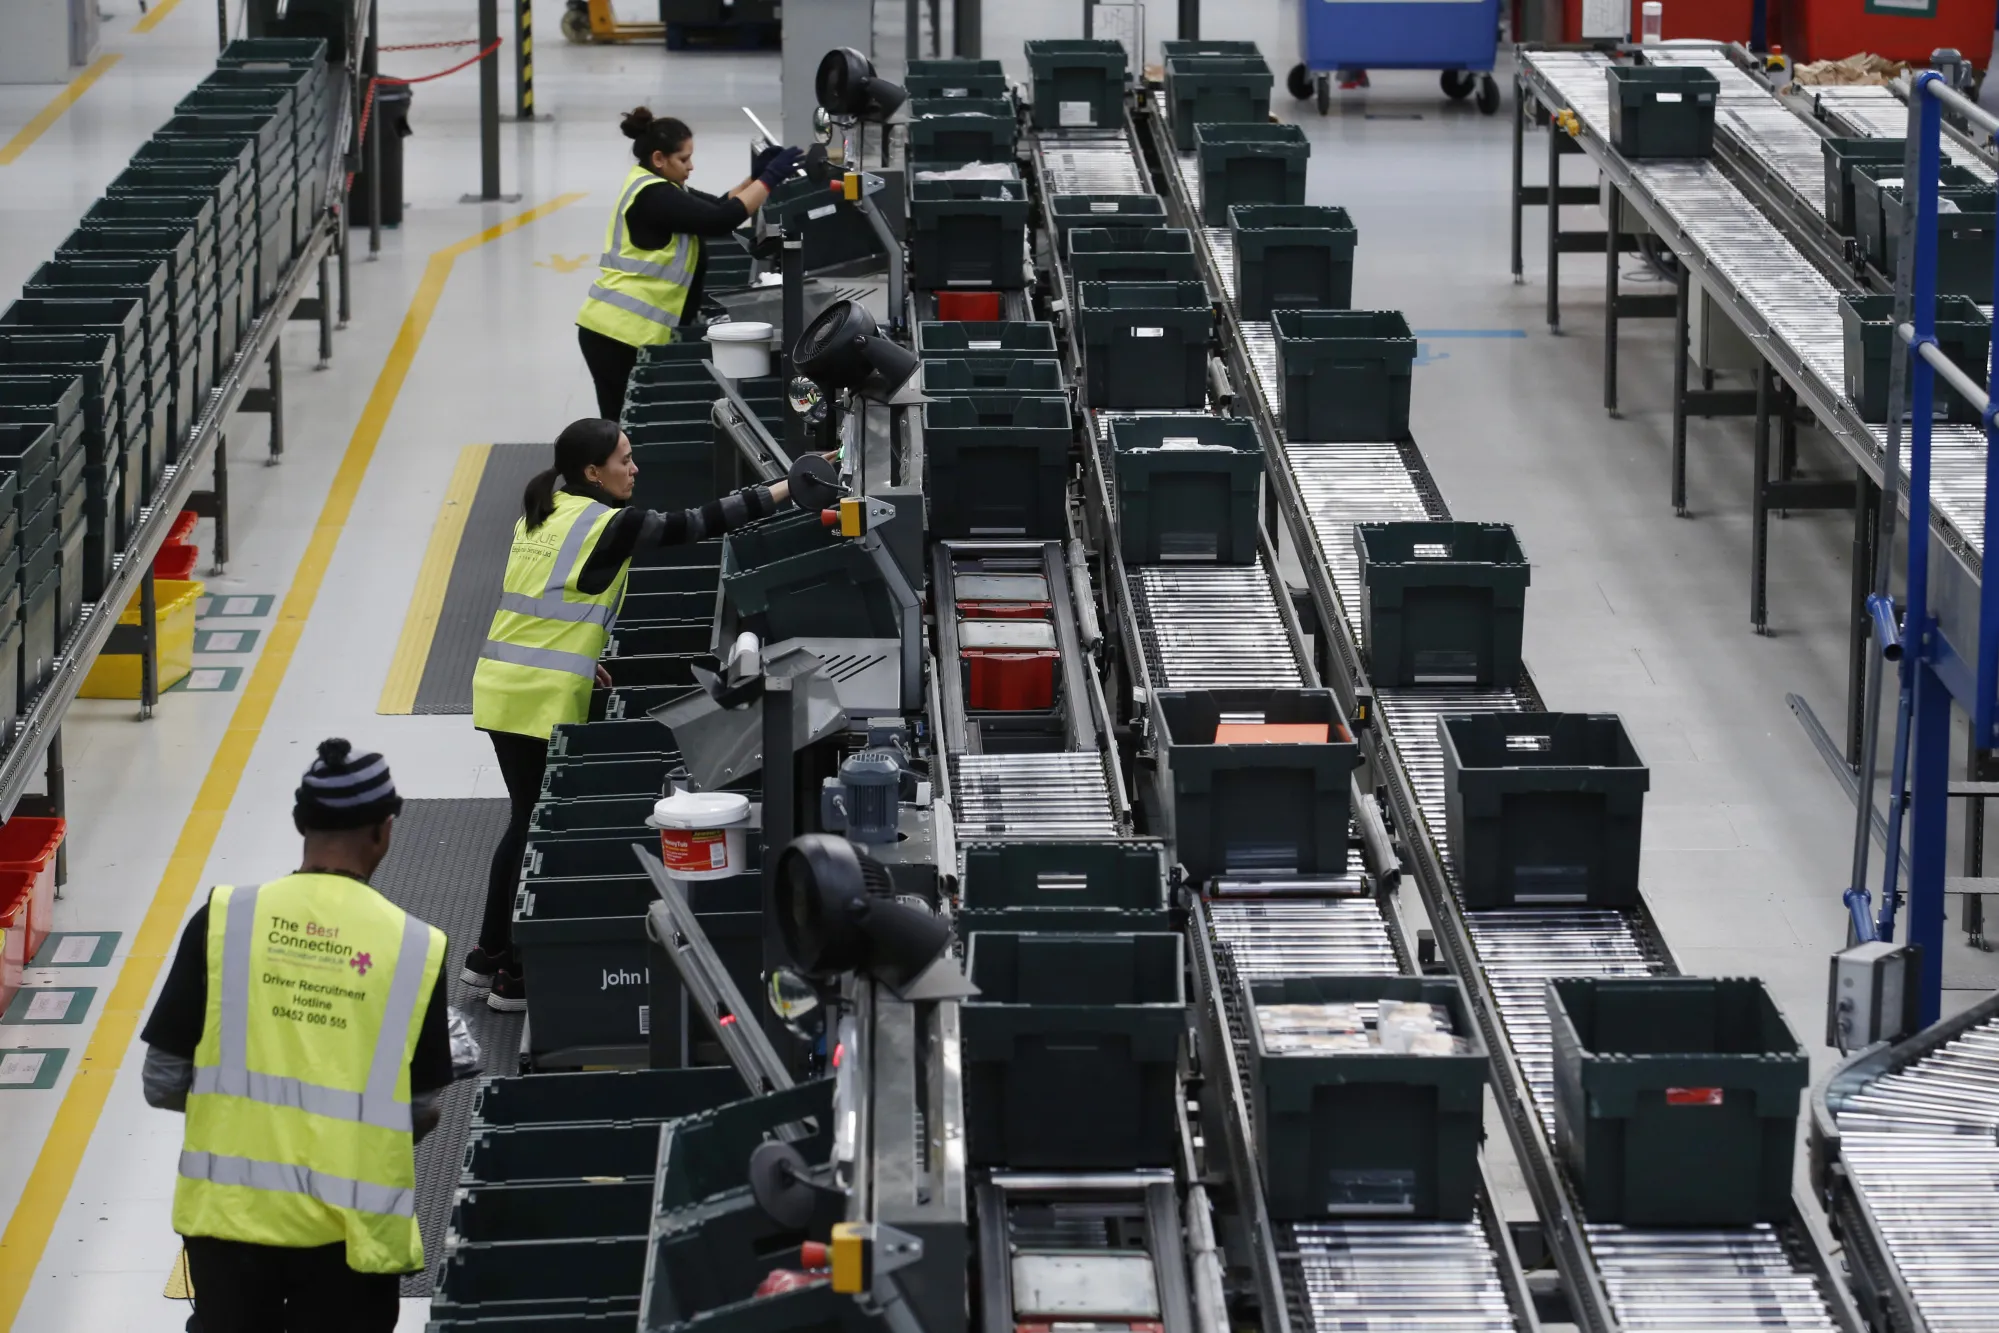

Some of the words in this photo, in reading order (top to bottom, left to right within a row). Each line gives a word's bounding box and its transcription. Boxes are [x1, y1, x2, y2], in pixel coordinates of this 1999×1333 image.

[271, 916, 299, 932] The
[306, 922, 339, 938] Best
[268, 930, 352, 956] Connection
[262, 972, 295, 988] Driver
[299, 980, 366, 1001] Recruitment
[600, 968, 641, 991] John
[293, 994, 332, 1011] Hotline
[272, 1005, 304, 1023] 03452
[307, 1012, 327, 1025] 000
